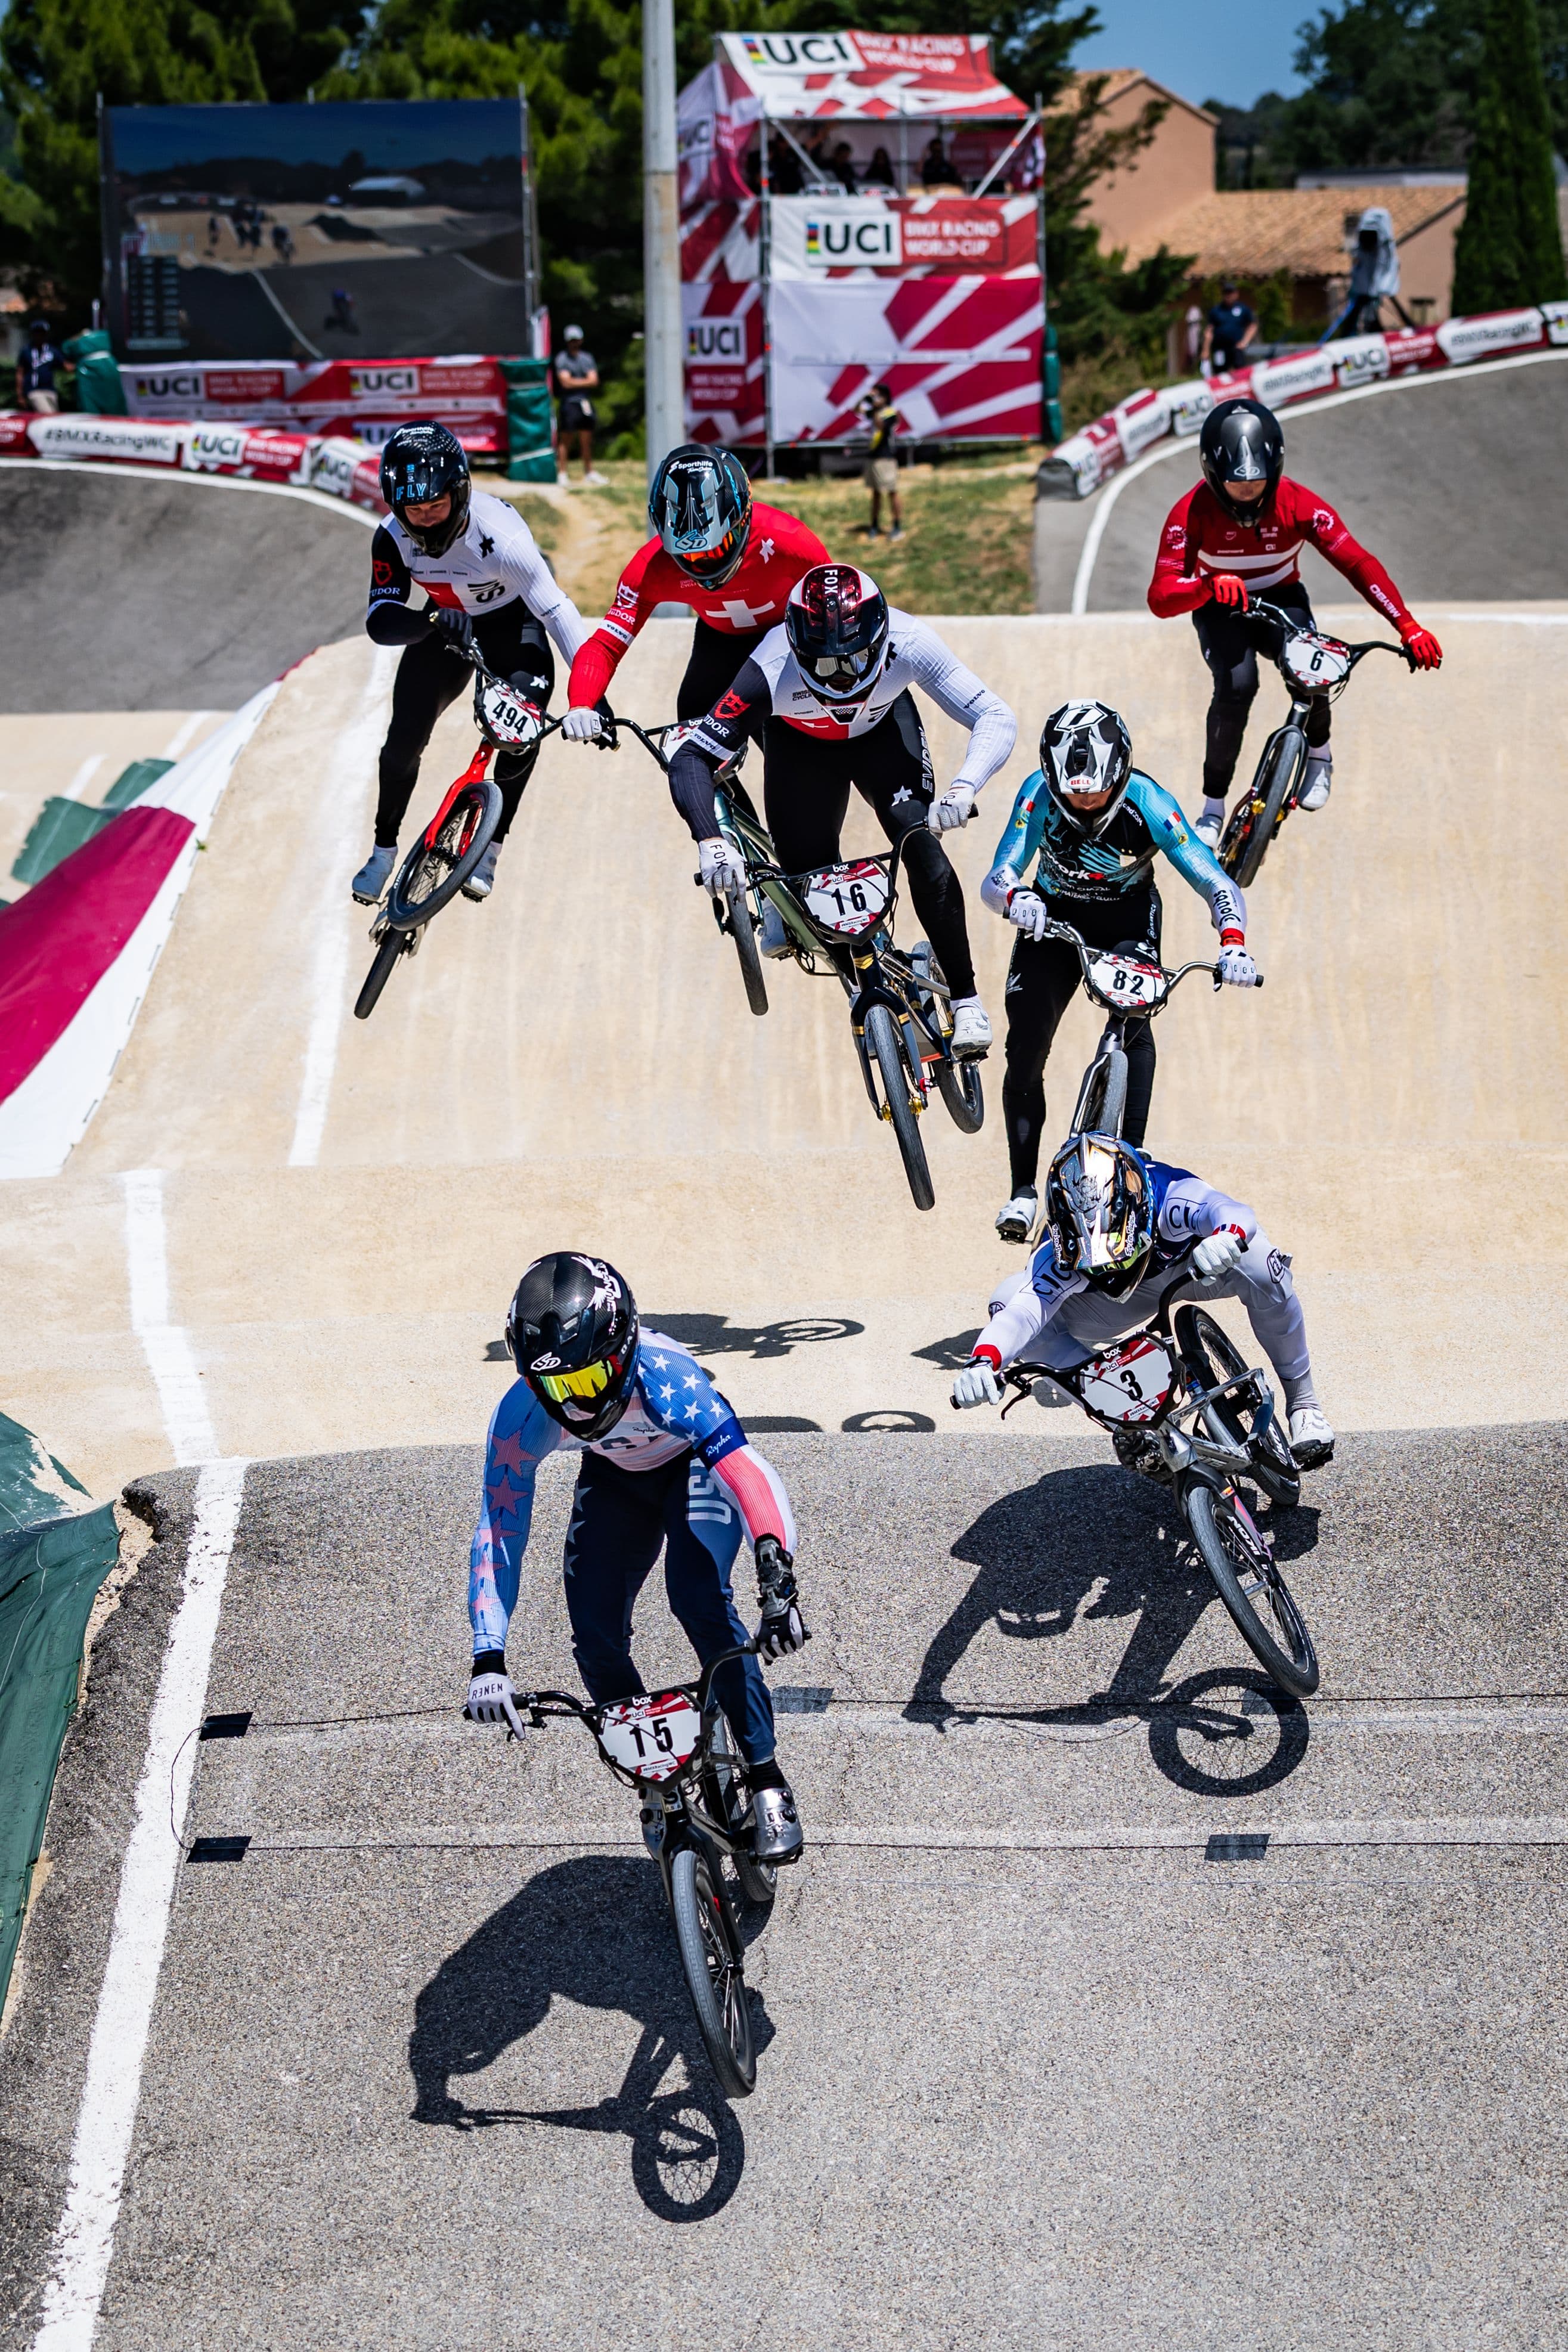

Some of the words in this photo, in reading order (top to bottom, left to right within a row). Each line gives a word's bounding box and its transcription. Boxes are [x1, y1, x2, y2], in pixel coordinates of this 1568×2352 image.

[762, 38, 848, 64] UCI
[898, 38, 963, 56] RACING
[825, 223, 891, 253] UCI
[942, 222, 999, 237] RACING
[905, 240, 955, 256] WORLD
[958, 240, 989, 255] CUP
[699, 326, 739, 355] UCI
[149, 377, 199, 396] UCI
[363, 373, 413, 391] UCI
[201, 435, 238, 455] UCI
[678, 461, 713, 469] Sporthilfe
[396, 483, 427, 500] FLY
[675, 529, 708, 550] 6D
[825, 569, 838, 594] FOX
[1369, 584, 1402, 618] MEYBO
[607, 624, 628, 639] VOLVO
[1310, 650, 1324, 671] 6
[515, 689, 527, 701] box
[963, 689, 986, 709] VOLVO
[492, 700, 528, 735] 494
[694, 733, 715, 749] VOLVO
[710, 844, 729, 869] FOX
[1046, 850, 1105, 881] work4
[832, 864, 850, 873] box
[831, 883, 867, 916] 16
[1113, 970, 1144, 996] 82
[1169, 1205, 1200, 1230] CIC
[1033, 1261, 1072, 1295] CIC
[530, 1352, 561, 1371] 6D
[1103, 1346, 1122, 1359] box
[1106, 1361, 1117, 1370] UCI
[1120, 1369, 1144, 1401] 3
[1226, 1516, 1260, 1555] IKON
[632, 1696, 652, 1706] box
[630, 1717, 673, 1758] 15
